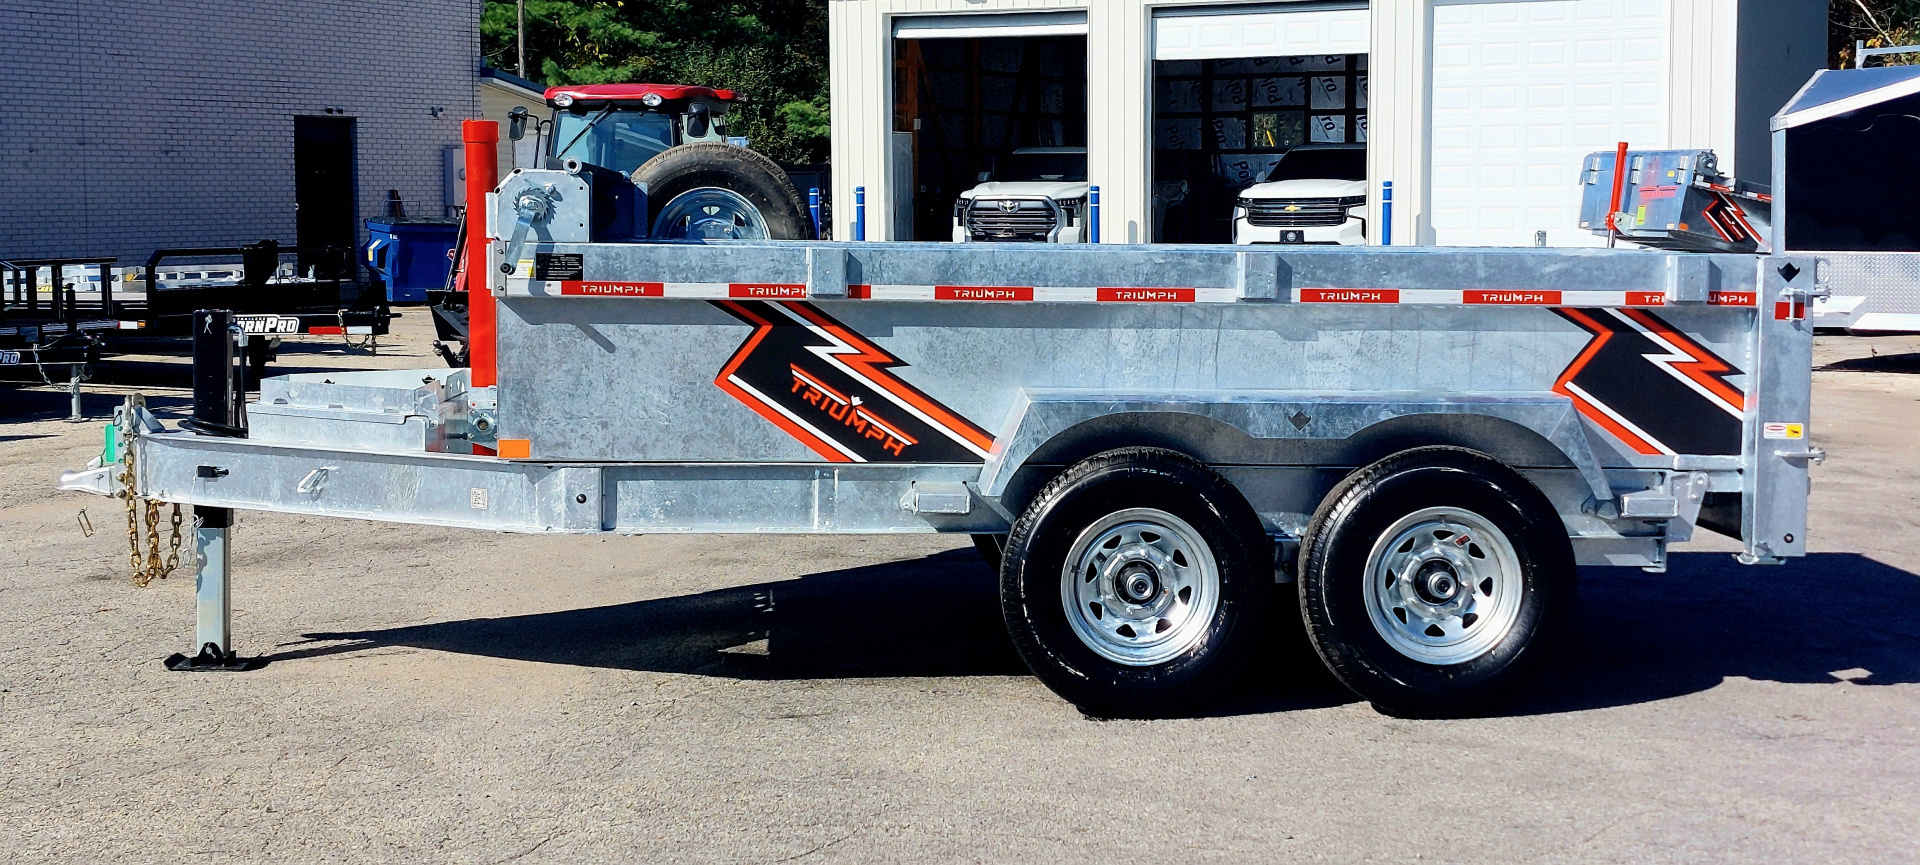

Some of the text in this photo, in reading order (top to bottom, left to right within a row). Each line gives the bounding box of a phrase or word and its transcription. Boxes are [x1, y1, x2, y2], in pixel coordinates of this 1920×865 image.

[581, 284, 645, 294] TRIUMPH
[953, 289, 1016, 299] TRIUMPH
[1115, 290, 1178, 300] TRIUMPH
[1319, 291, 1382, 301] TRIUMPH
[1482, 292, 1545, 302] TRIUMPH
[791, 376, 906, 457] TRIUMPH
